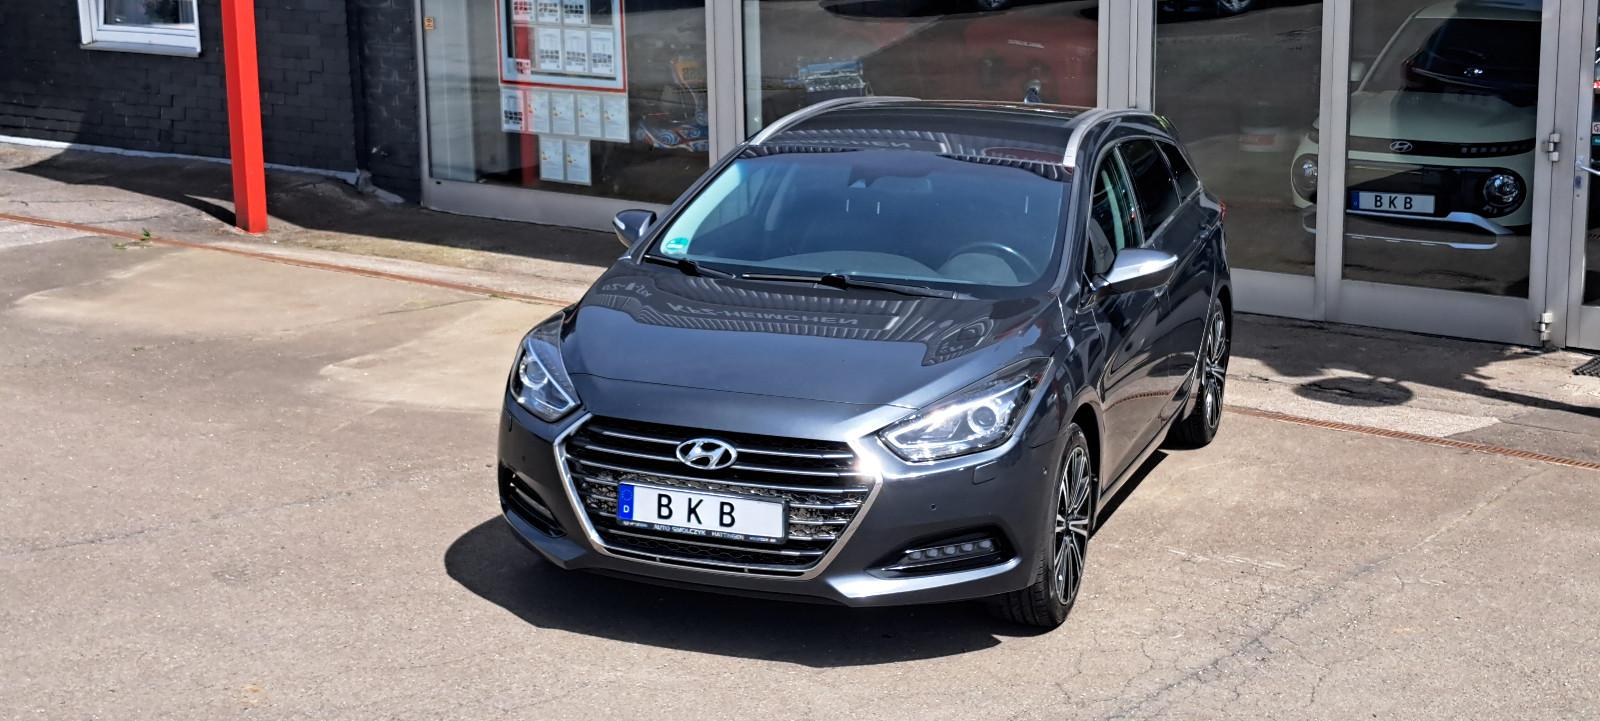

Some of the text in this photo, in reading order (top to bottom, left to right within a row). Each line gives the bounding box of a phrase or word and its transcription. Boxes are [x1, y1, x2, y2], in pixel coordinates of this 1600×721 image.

[1375, 195, 1413, 209] B K B
[623, 504, 630, 513] D
[657, 493, 736, 528] B K B
[672, 527, 706, 535] SMOLCZYK
[711, 532, 744, 540] HATTINGEN
